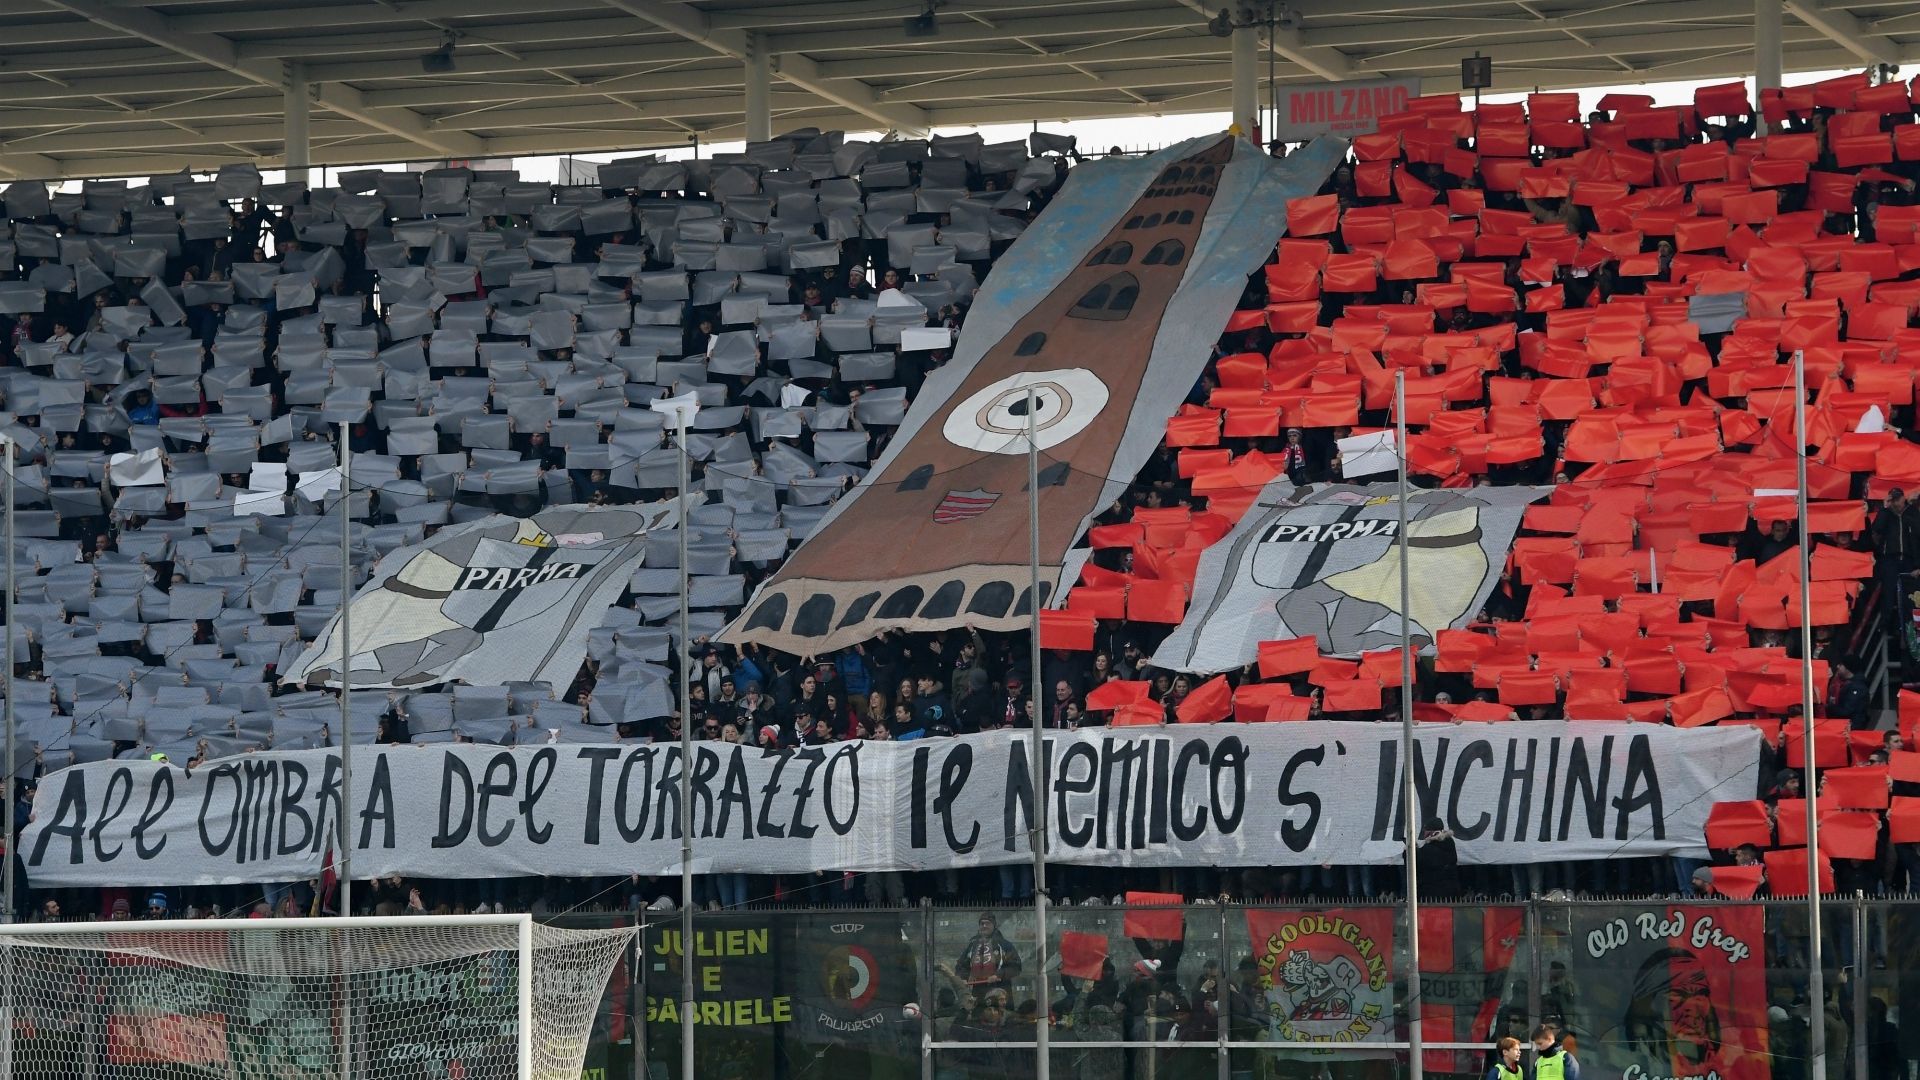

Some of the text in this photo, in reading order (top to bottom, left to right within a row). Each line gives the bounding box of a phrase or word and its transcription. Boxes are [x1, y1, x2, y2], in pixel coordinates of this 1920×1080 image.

[1290, 85, 1409, 125] MILZANO
[1268, 519, 1399, 543] PARMA
[460, 562, 581, 590] PARMA
[576, 740, 864, 845] TORRAZZO
[653, 928, 768, 957] JULIEN
[1587, 911, 1750, 963] Old Red Grey
[703, 966, 721, 992] E
